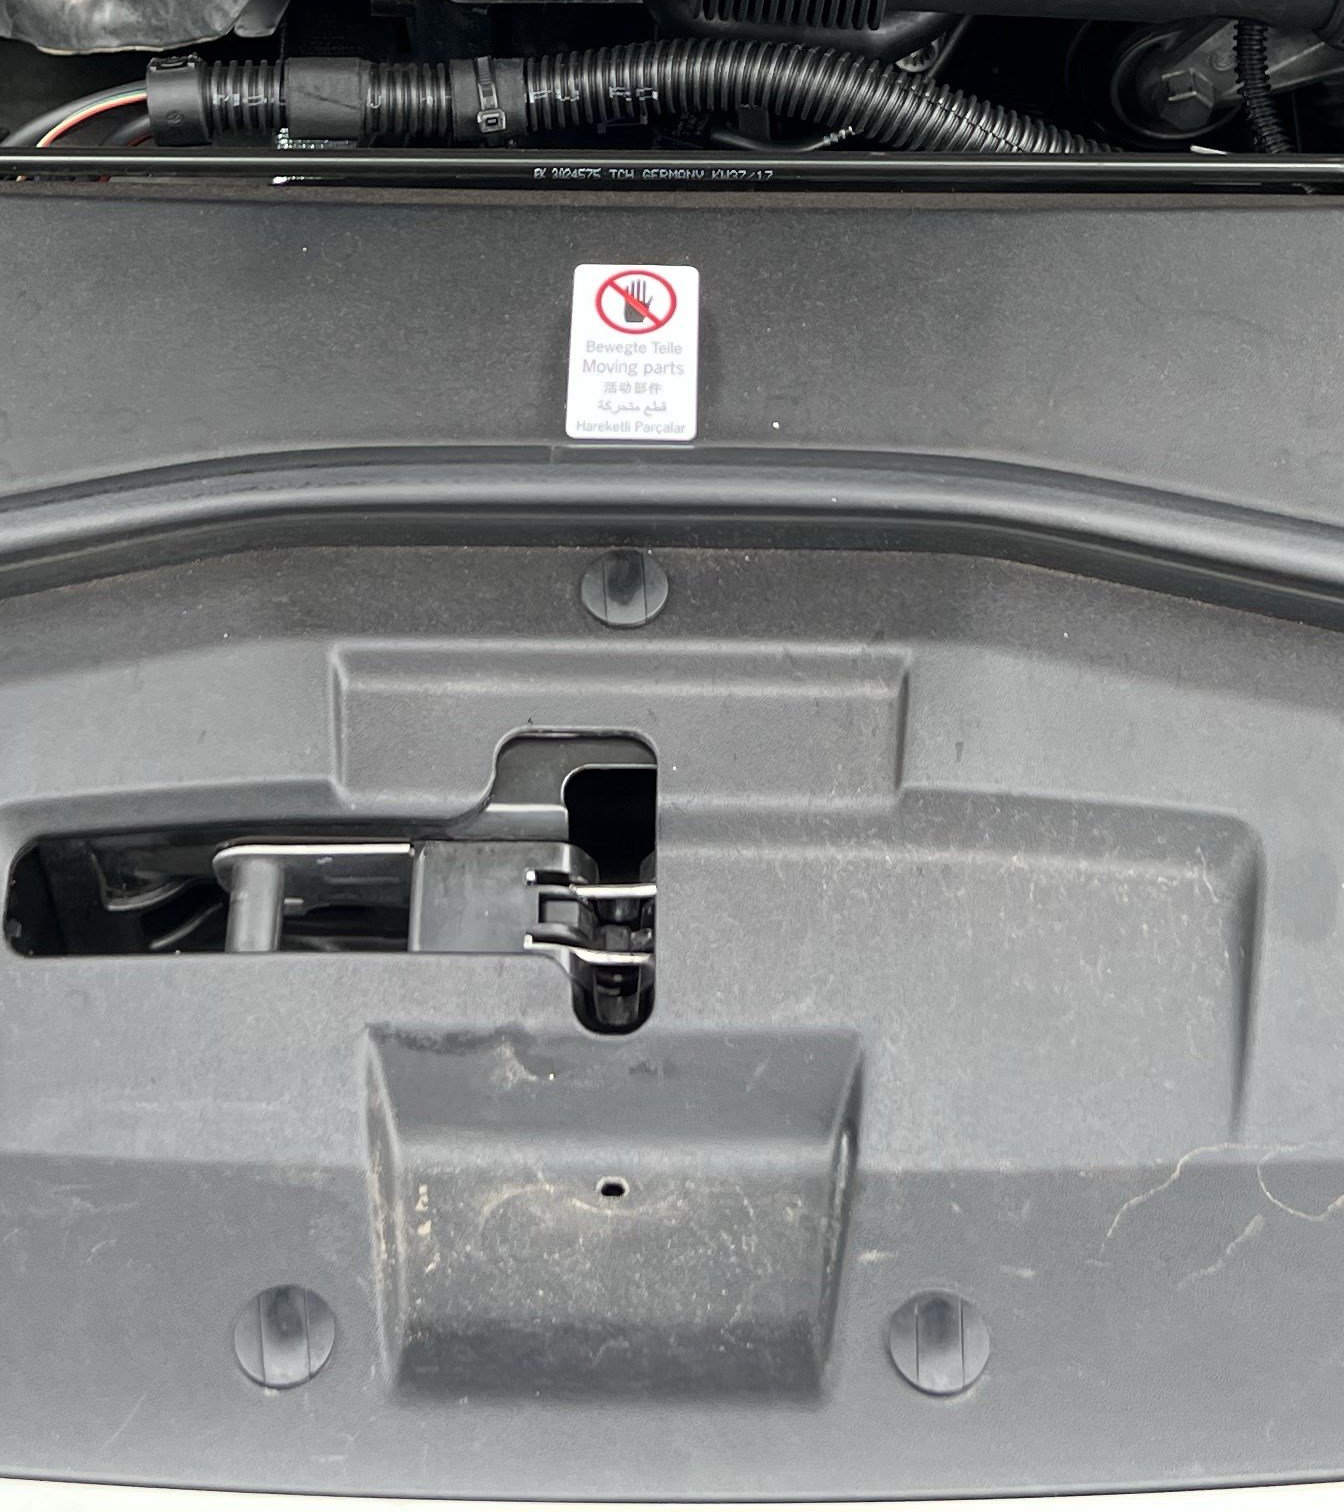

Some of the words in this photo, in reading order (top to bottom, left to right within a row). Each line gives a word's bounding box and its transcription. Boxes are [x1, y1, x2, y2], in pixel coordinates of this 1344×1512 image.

[642, 168, 705, 180] GERMANY
[585, 340, 647, 356] Bewegte
[651, 341, 683, 355] Teile
[582, 359, 639, 376] Moving
[643, 360, 685, 376] parts
[603, 381, 662, 395] 活动部件
[576, 420, 632, 433] Hareketli
[635, 420, 686, 435] Parçalar
